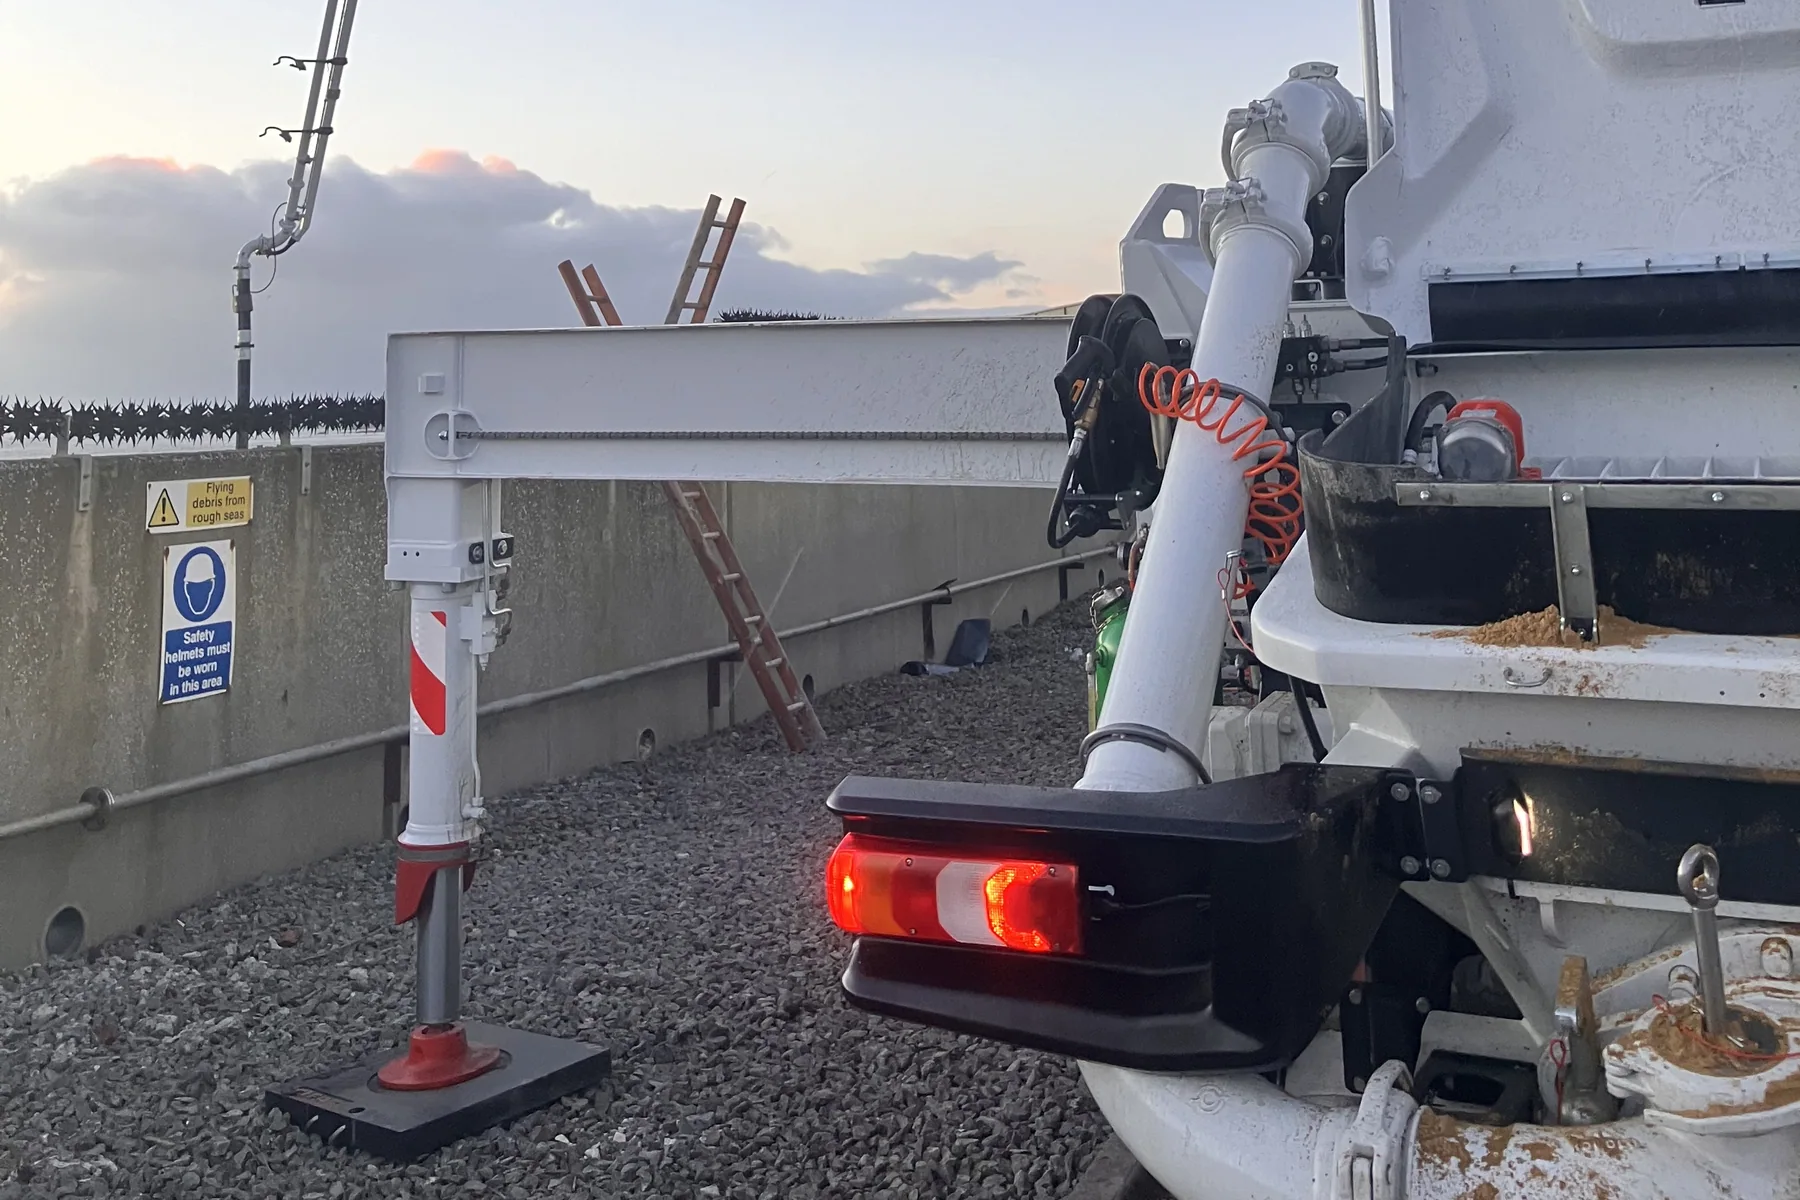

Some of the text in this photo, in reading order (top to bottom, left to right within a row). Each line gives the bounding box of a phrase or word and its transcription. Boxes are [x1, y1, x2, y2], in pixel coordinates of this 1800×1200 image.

[206, 481, 234, 495] Flying
[192, 495, 246, 509] debris from
[192, 510, 245, 525] rough seas
[183, 629, 215, 644] Safety
[165, 641, 231, 664] helmets must
[178, 661, 218, 678] be worn
[169, 676, 223, 696] in this area
